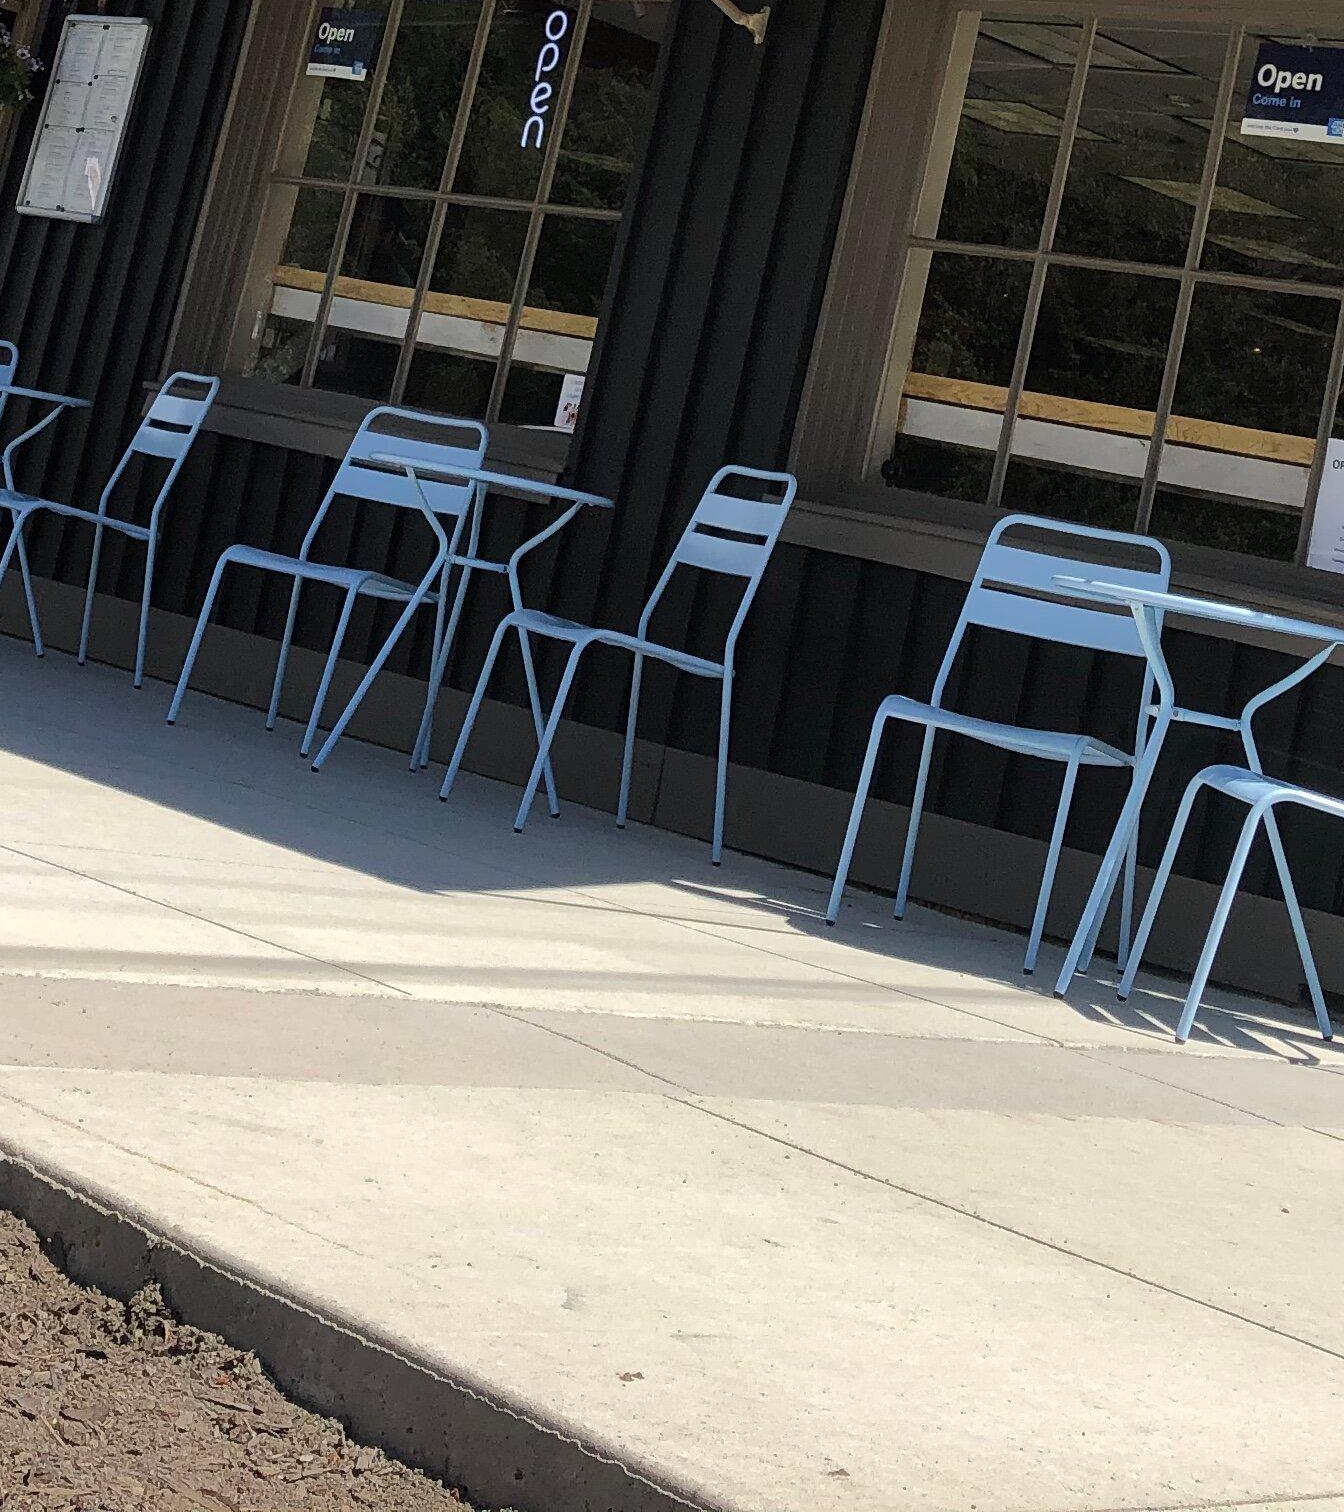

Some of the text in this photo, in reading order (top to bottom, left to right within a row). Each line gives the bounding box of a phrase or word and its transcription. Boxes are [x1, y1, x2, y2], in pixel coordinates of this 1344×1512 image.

[318, 22, 355, 44] Open
[1257, 63, 1323, 93] Open
[1252, 93, 1302, 108] Come in
